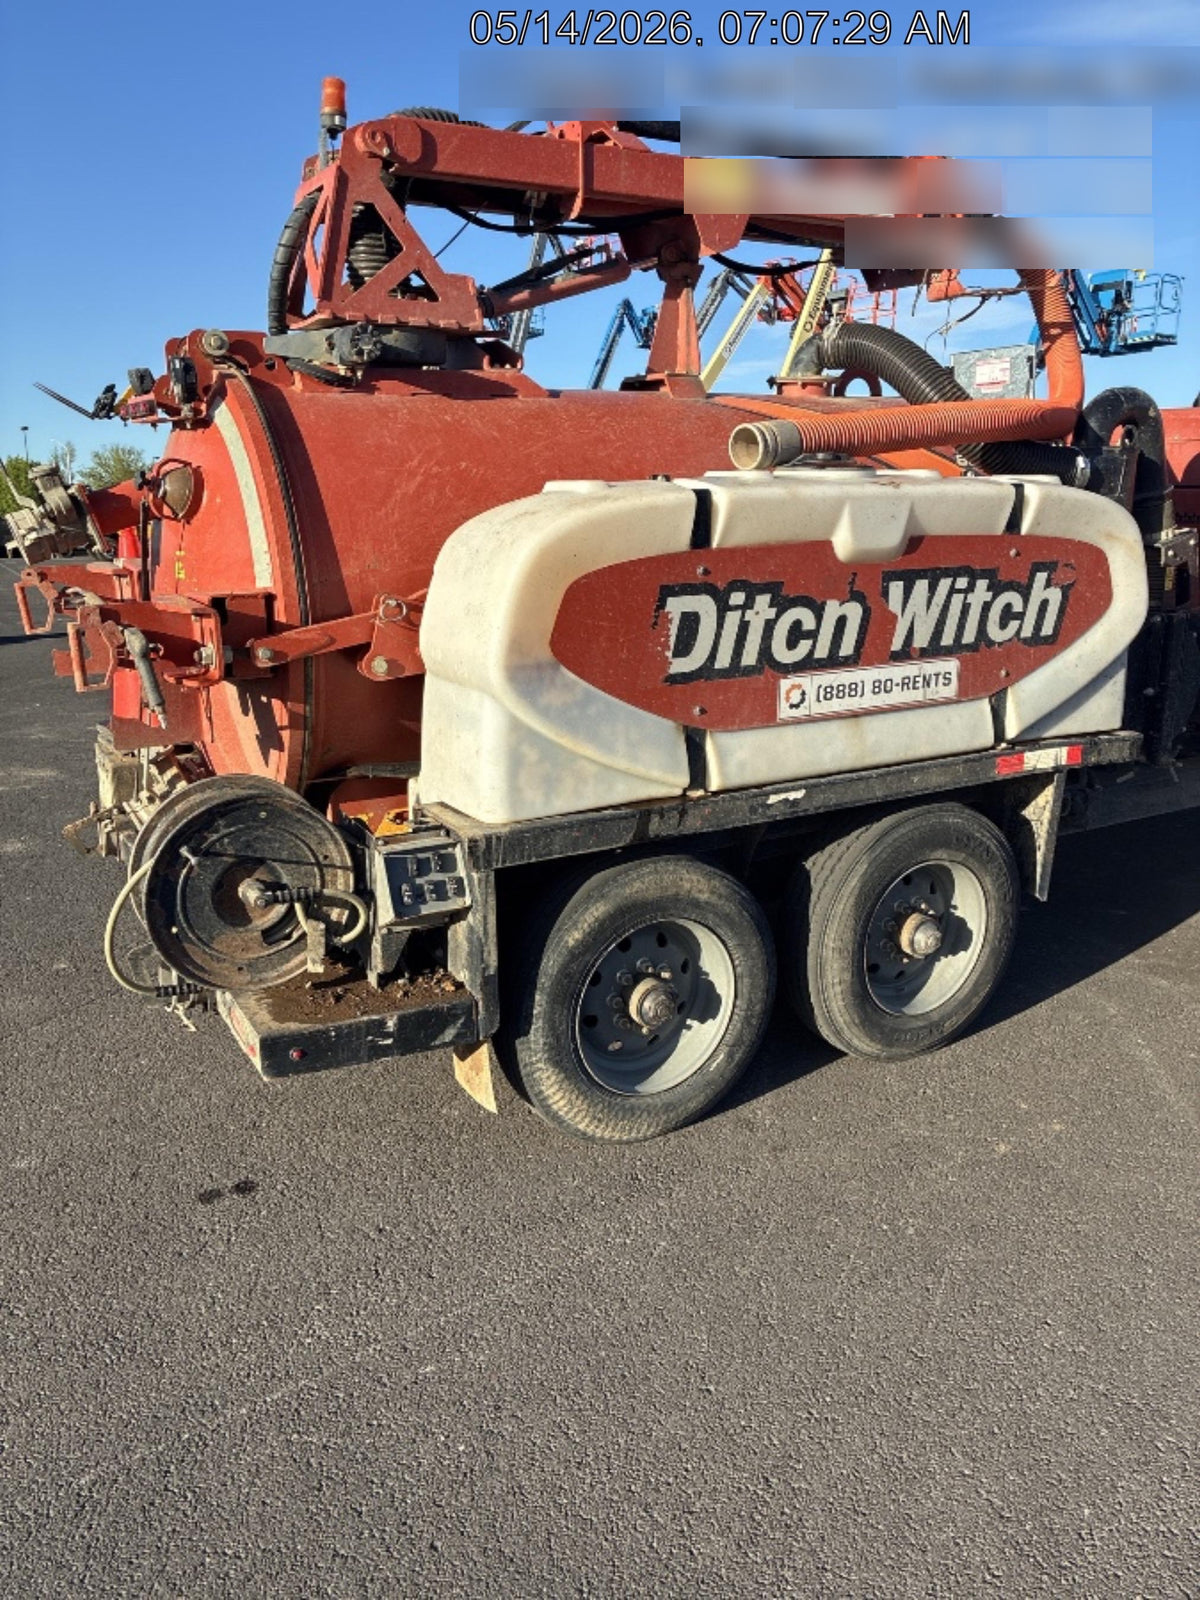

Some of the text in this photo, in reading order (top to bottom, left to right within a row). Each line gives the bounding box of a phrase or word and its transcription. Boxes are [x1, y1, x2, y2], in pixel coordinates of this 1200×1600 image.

[886, 567, 1066, 655] Witch
[816, 671, 953, 703] (888) 80-RENTS
